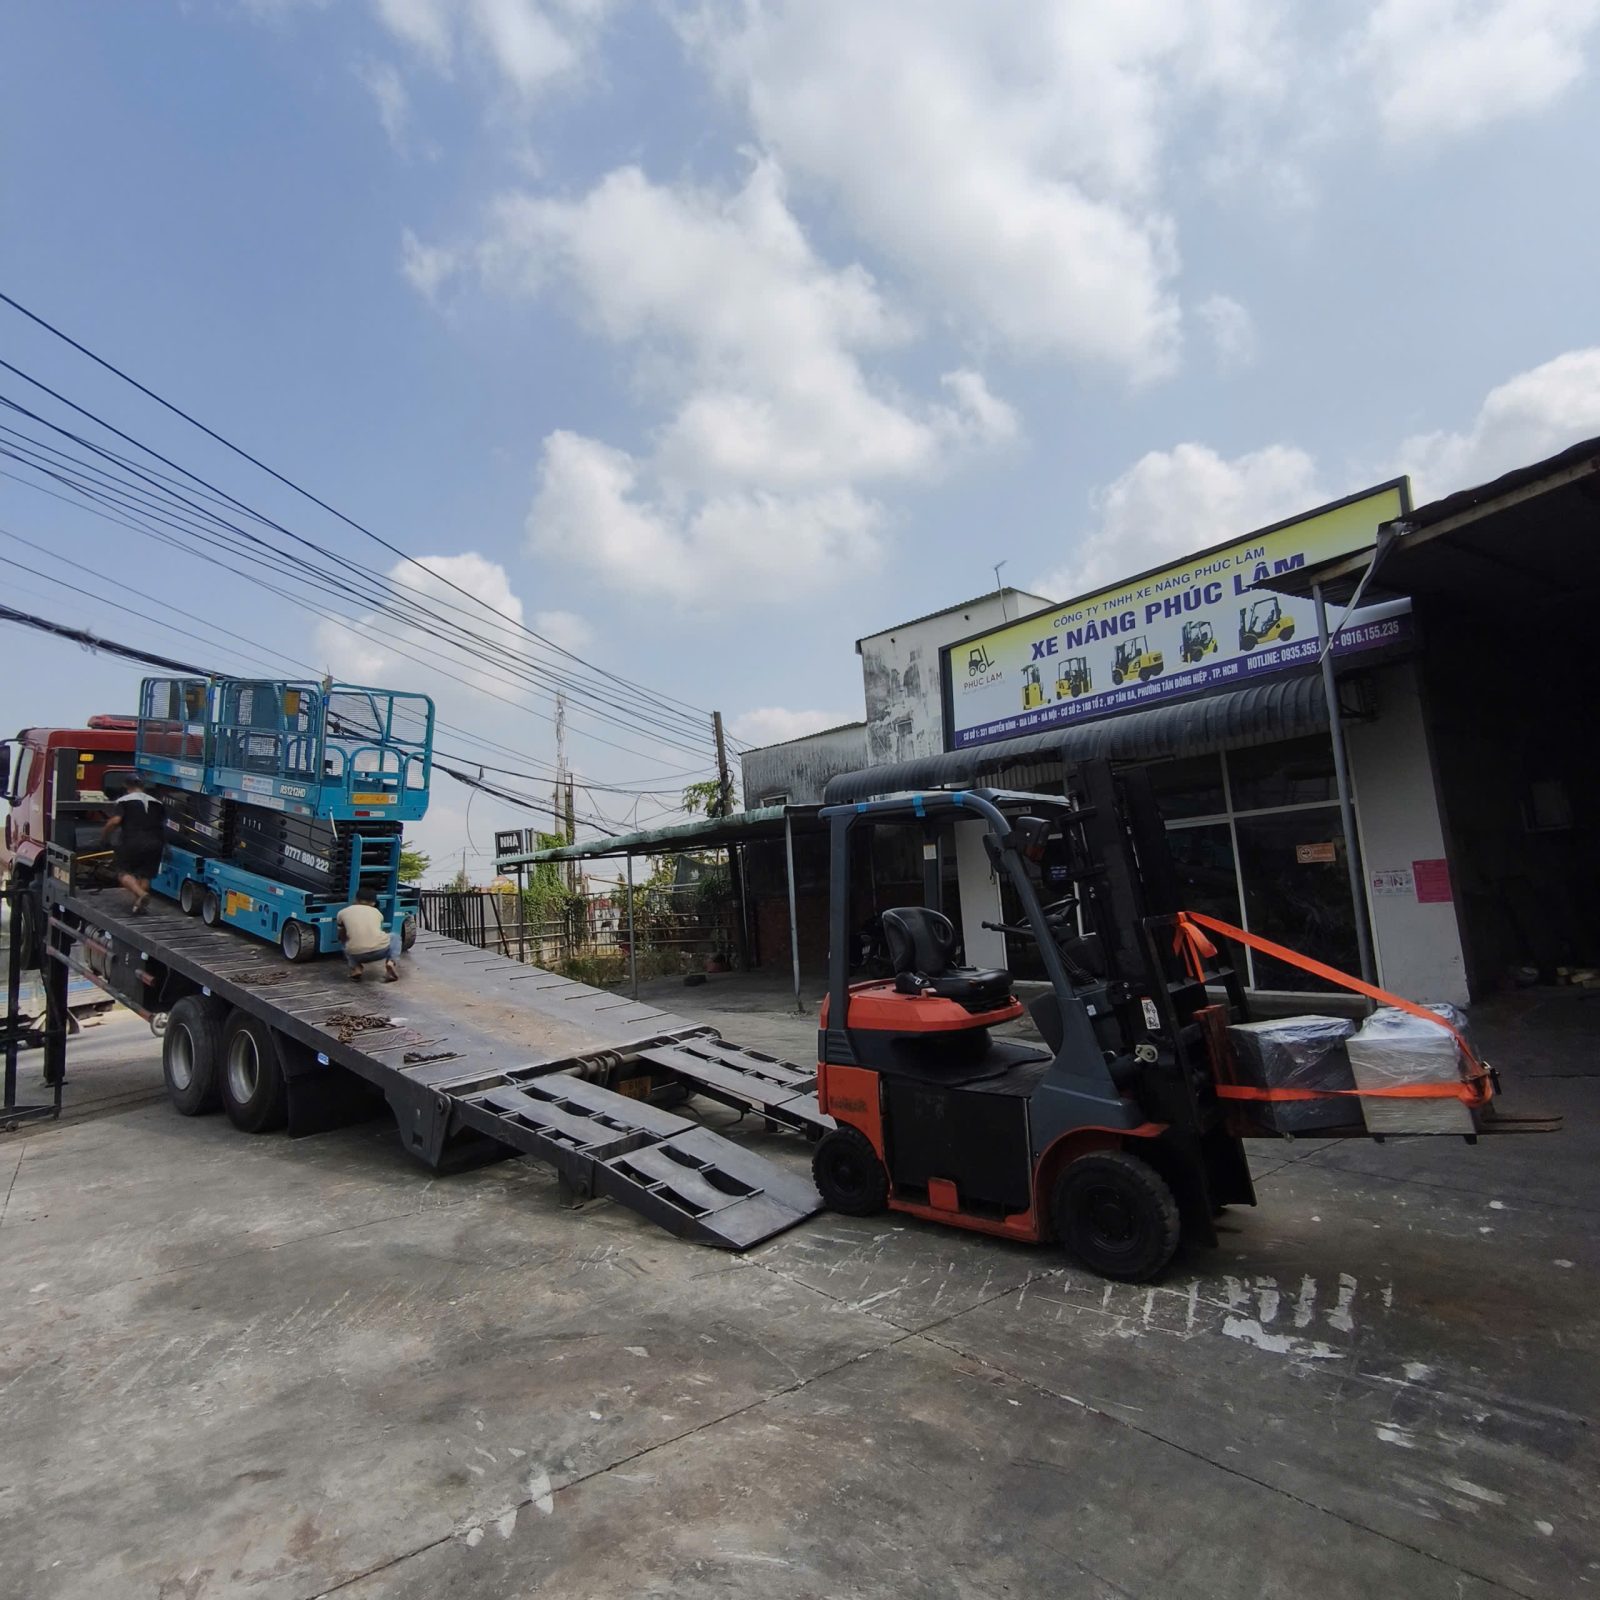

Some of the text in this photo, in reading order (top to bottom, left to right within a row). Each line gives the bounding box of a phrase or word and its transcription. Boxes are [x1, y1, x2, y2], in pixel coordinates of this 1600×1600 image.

[1053, 546, 1265, 628] CÔNG TY TNHH XE NÂNG PHÚC LÂM
[1031, 636, 1059, 661] XE
[1066, 610, 1136, 650] NÂNG
[1145, 581, 1223, 625] PHÚC
[1247, 651, 1280, 670] HOTLINE:
[1281, 636, 1334, 661] 0935.355.5
[1341, 620, 1399, 647] 0916.155.235
[1222, 663, 1238, 676] HCM
[500, 833, 519, 848] NHÀ
